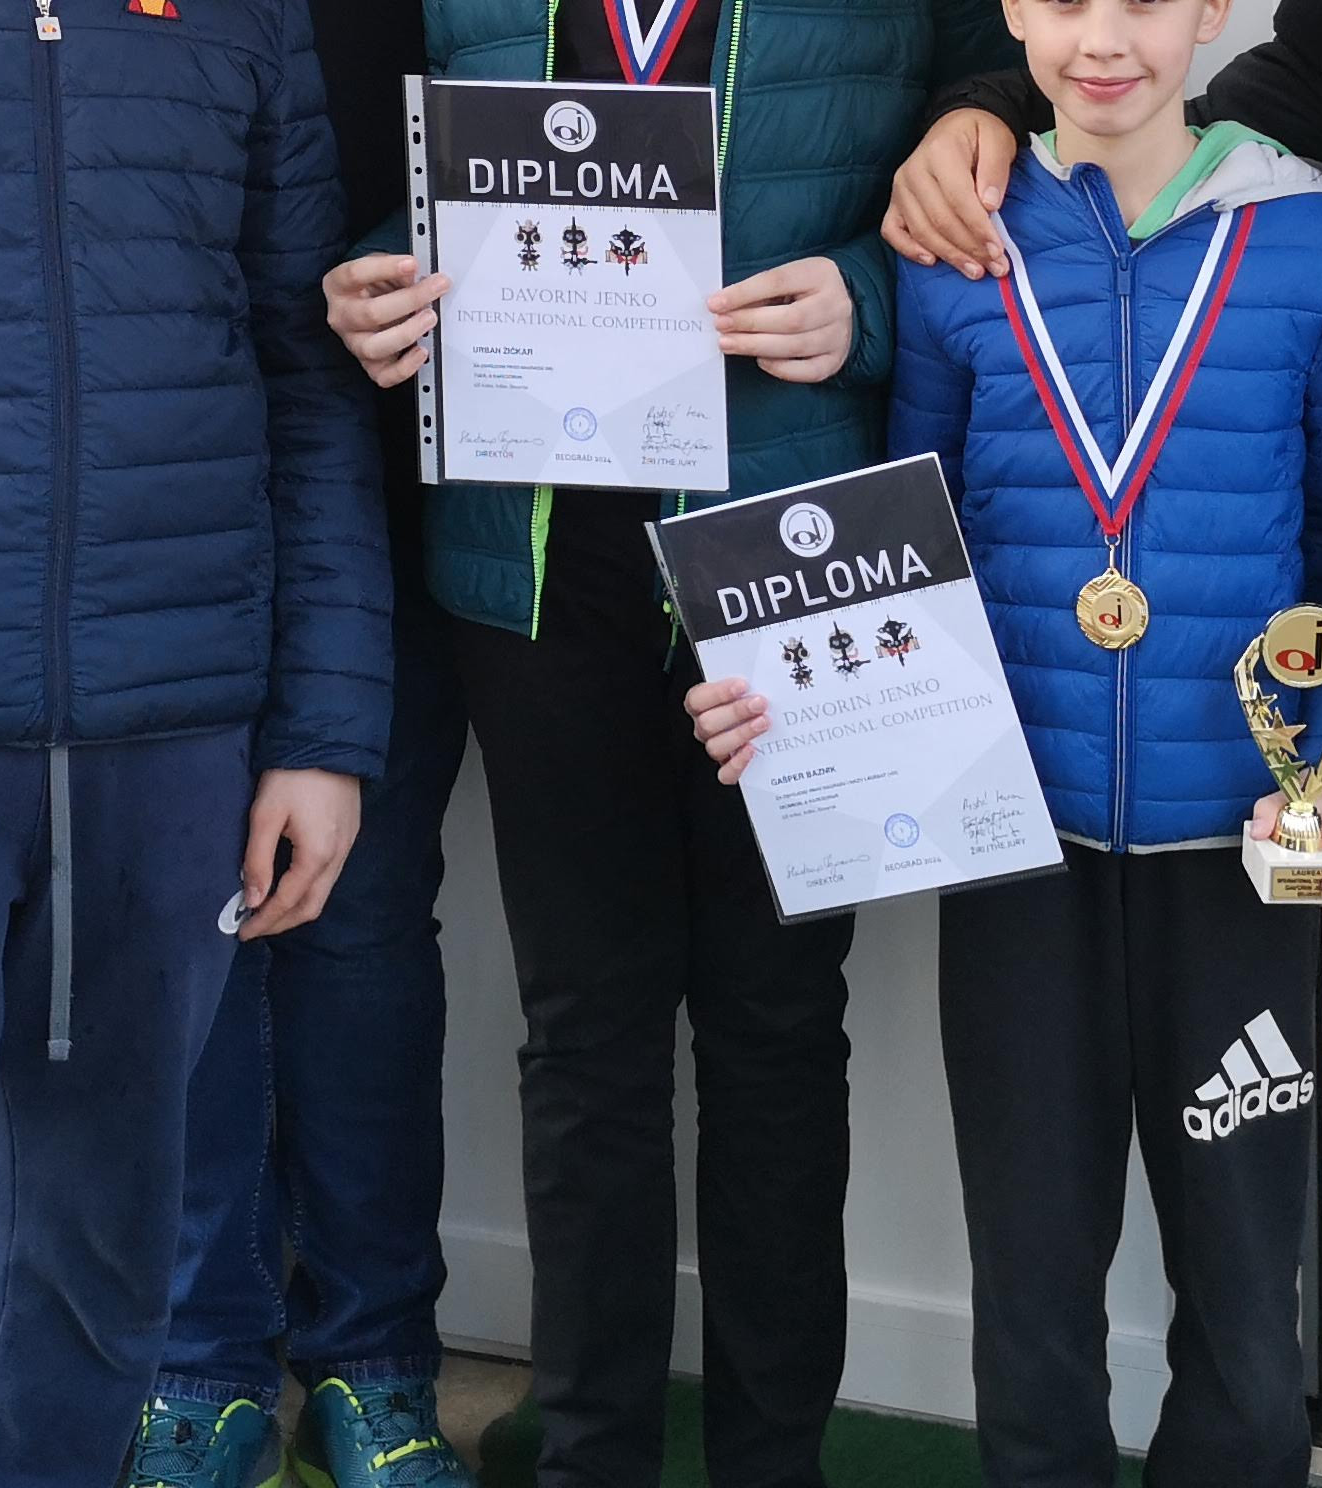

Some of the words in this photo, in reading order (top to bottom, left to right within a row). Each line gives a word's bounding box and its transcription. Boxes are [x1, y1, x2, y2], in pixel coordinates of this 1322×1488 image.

[467, 157, 679, 202] DIPLOMA
[457, 309, 588, 328] INTERNATIONAL
[591, 315, 704, 333] COMPETITION
[501, 287, 588, 305] DAVORIN
[593, 290, 658, 308] JENKO
[716, 542, 933, 627] DIPLOMA
[751, 719, 877, 757] NTERNATIONAL
[881, 693, 994, 728] COMPETITION
[783, 693, 872, 727] DAVORIN
[878, 678, 941, 706] JENKO
[884, 858, 923, 873] BEOGRAD
[1182, 1070, 1315, 1142] adidas
